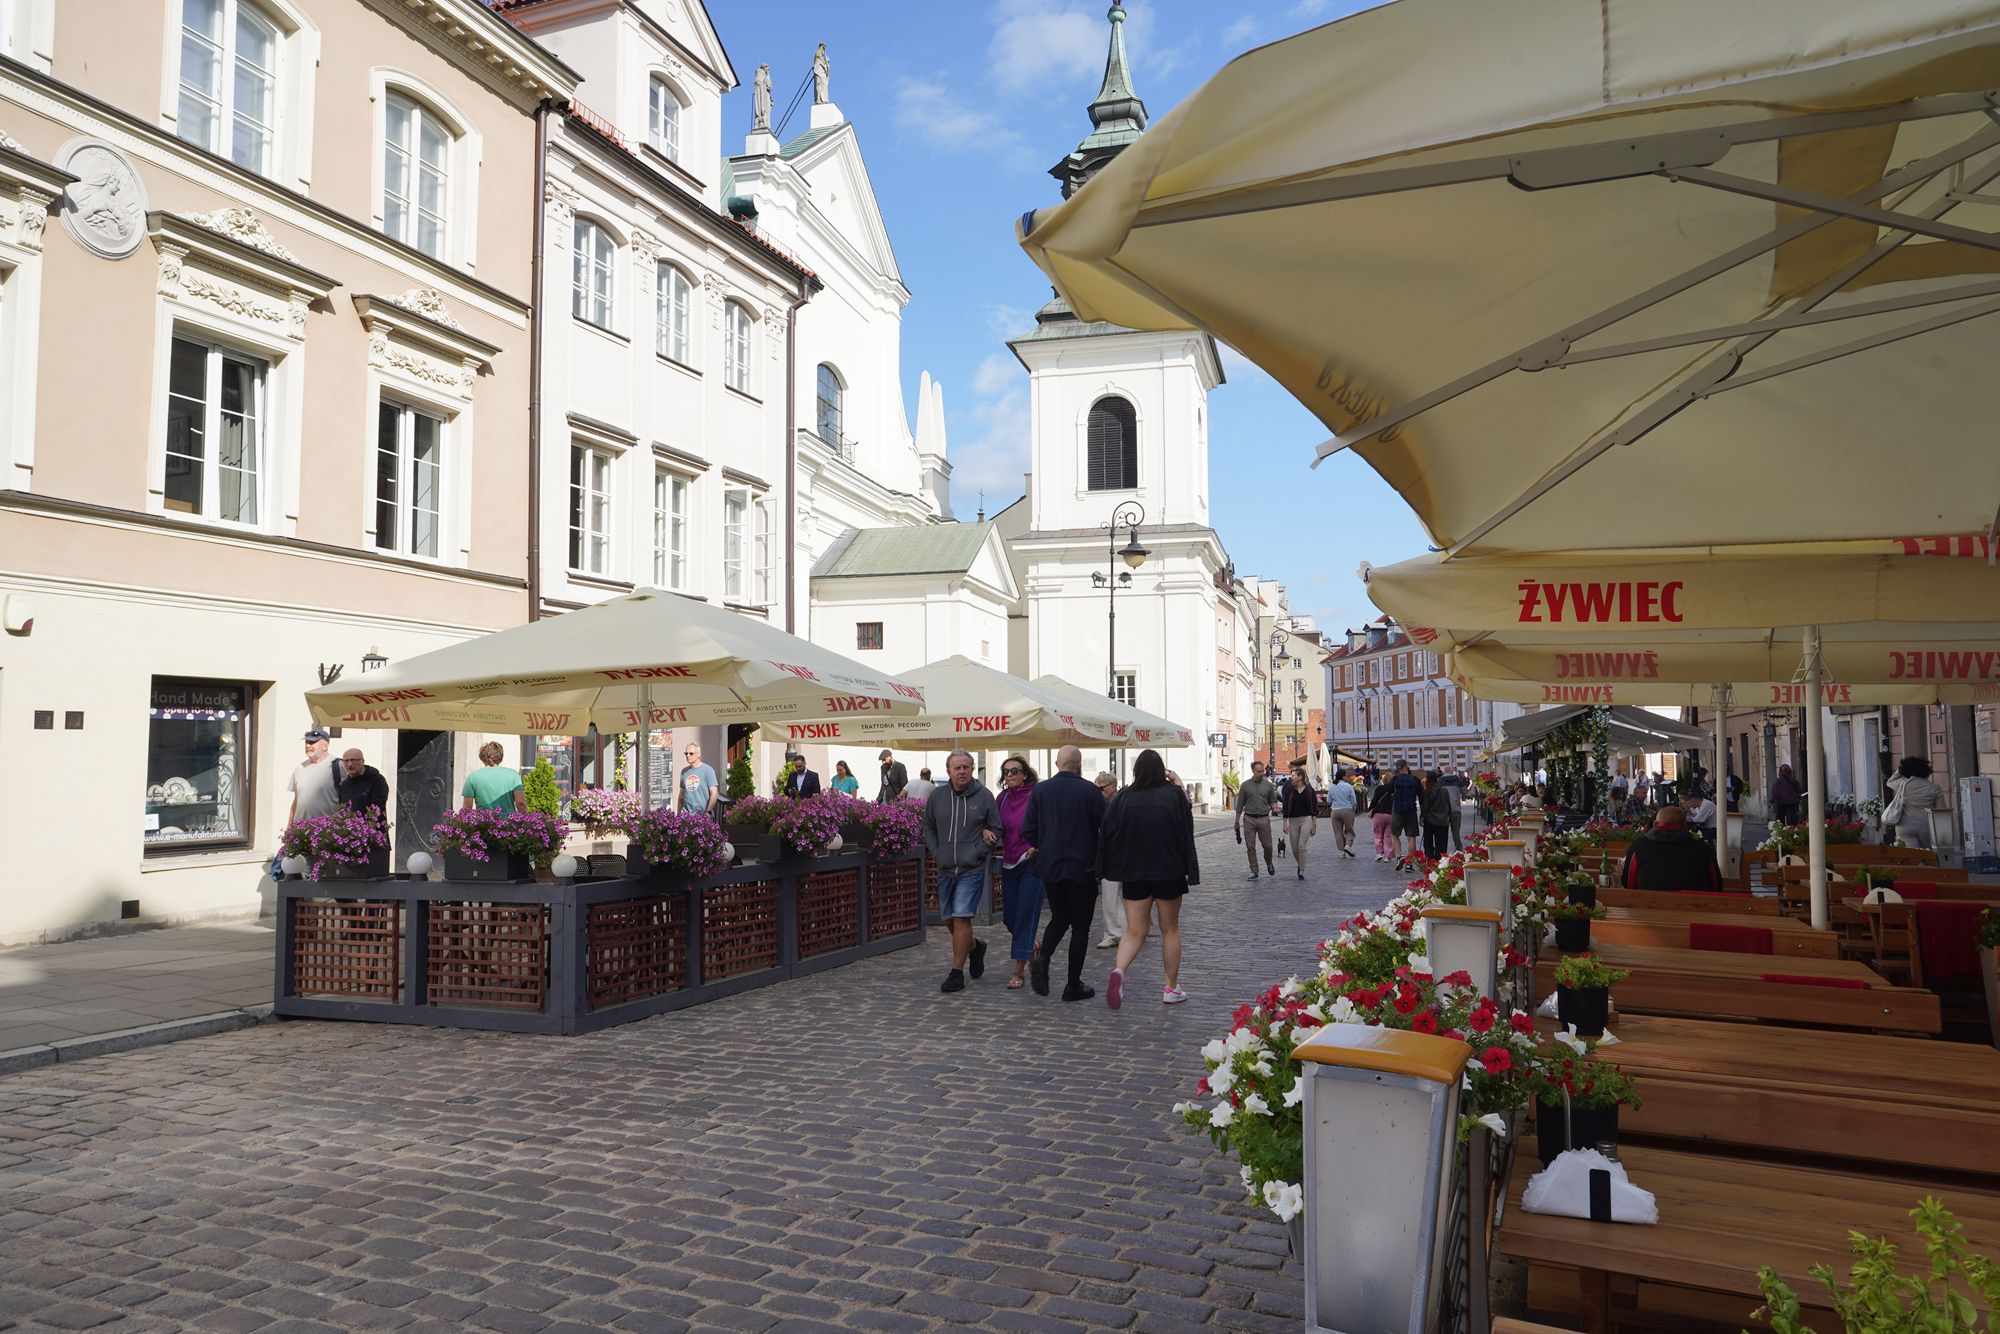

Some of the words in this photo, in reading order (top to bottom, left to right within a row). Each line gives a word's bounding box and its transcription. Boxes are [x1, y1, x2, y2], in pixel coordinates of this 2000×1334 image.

[1518, 578, 1684, 623] ŻYWIEC
[594, 665, 698, 681] TYSKIE
[151, 690, 186, 704] Hand
[192, 692, 230, 706] Made
[347, 688, 436, 705] TYSKIE
[786, 722, 841, 739] TYSKIE
[860, 722, 895, 730] TRATTORIA
[952, 715, 1012, 732] TYSKIE
[144, 829, 239, 842] www.e-manufaktura.com
